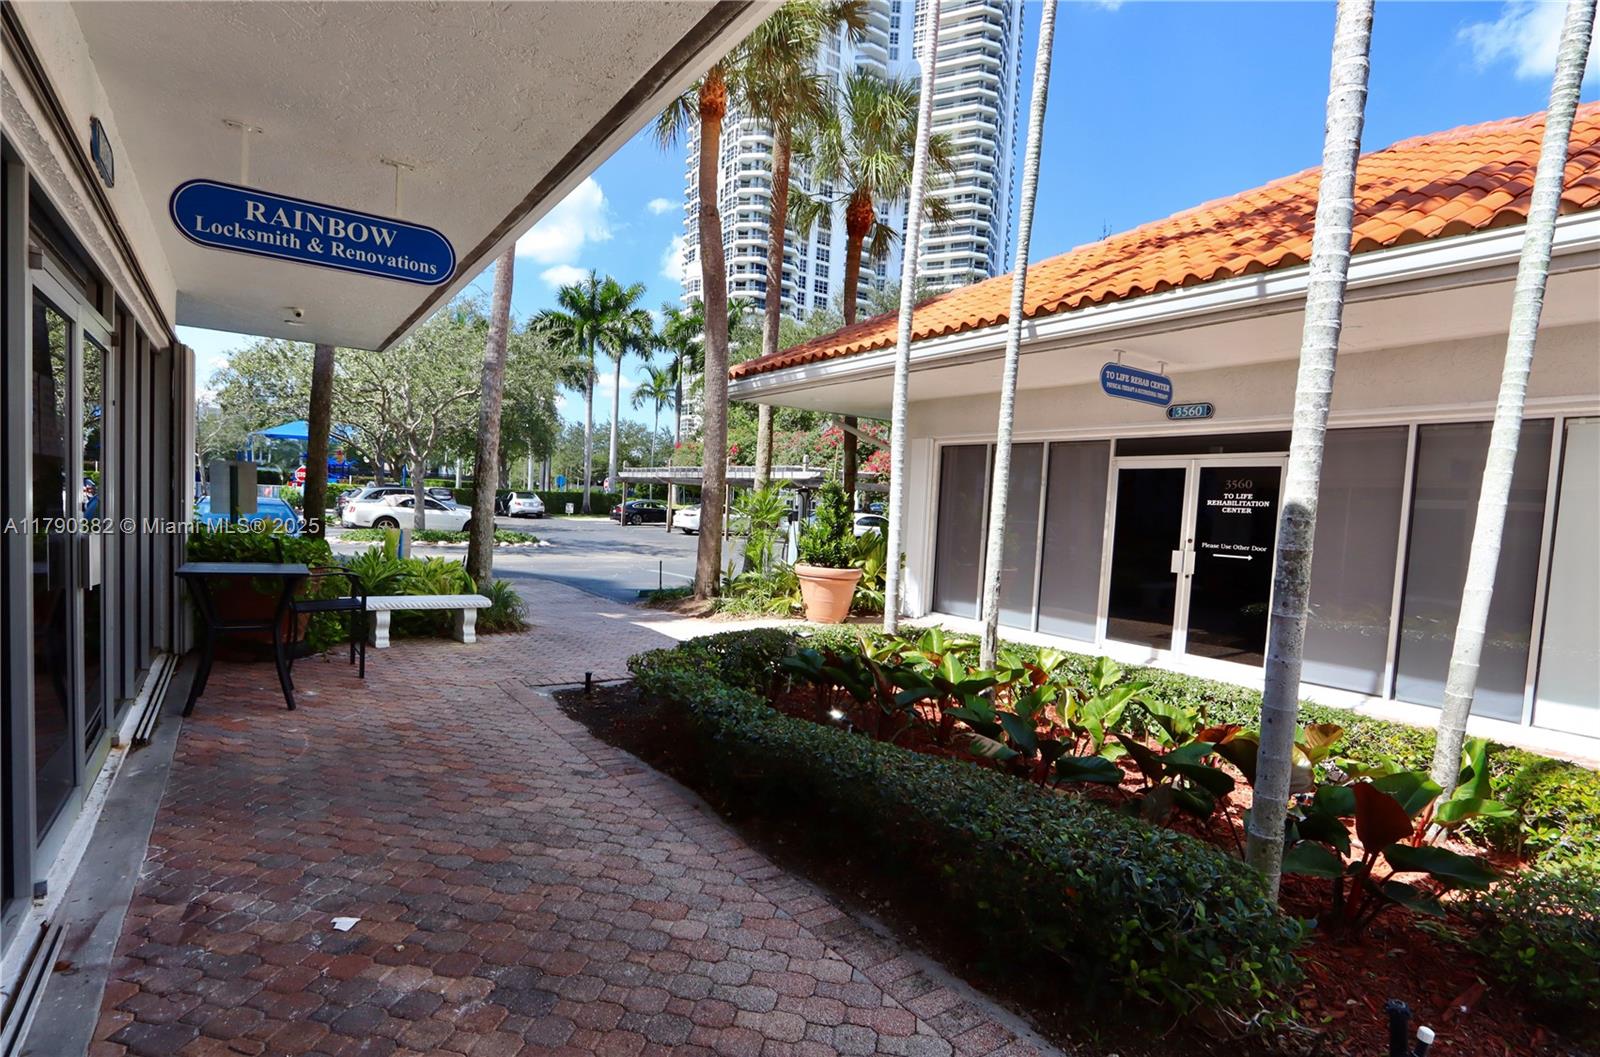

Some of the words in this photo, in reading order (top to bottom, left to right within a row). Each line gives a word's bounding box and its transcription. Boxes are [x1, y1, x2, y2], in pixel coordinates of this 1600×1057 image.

[245, 199, 398, 248] RAINBOW
[195, 215, 301, 250] Locksmith
[307, 236, 324, 254] &
[331, 241, 437, 275] Renovations
[1106, 371, 1115, 379] TO
[1116, 373, 1129, 382] LIFE
[1130, 375, 1150, 386] REHAB
[1150, 380, 1170, 392] CENTER
[1175, 406, 1203, 417] 3560
[1225, 480, 1253, 489] 3560
